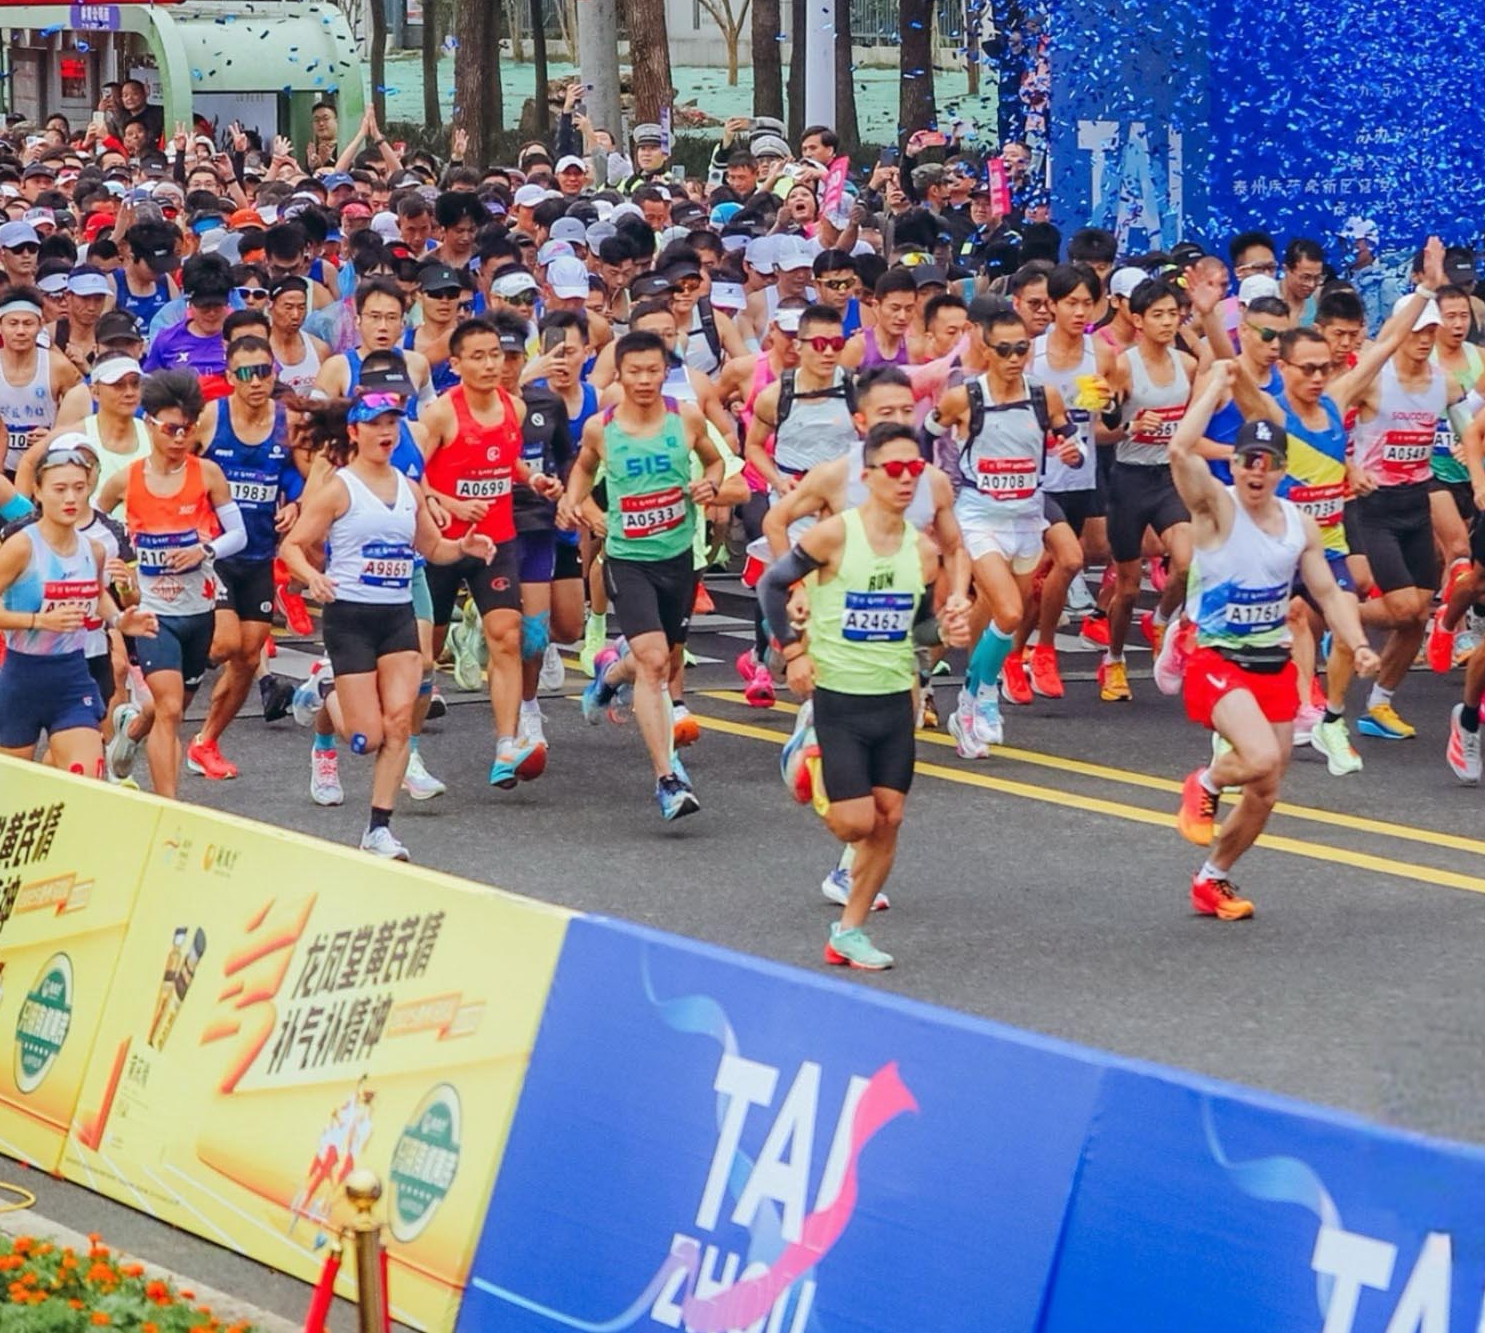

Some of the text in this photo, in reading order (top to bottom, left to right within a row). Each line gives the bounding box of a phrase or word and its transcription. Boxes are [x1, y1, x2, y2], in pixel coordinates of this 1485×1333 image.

[459, 480, 504, 496] A0699
[981, 474, 1025, 488] A0708
[234, 484, 268, 501] 1983
[626, 508, 674, 528] A0533
[365, 561, 408, 577] A9869
[867, 572, 895, 592] RUN
[845, 612, 900, 630] A2462
[291, 910, 446, 1000] 龙凤堂黄芪精
[267, 992, 395, 1076] 补气补精神
[694, 1052, 871, 1246] TAI
